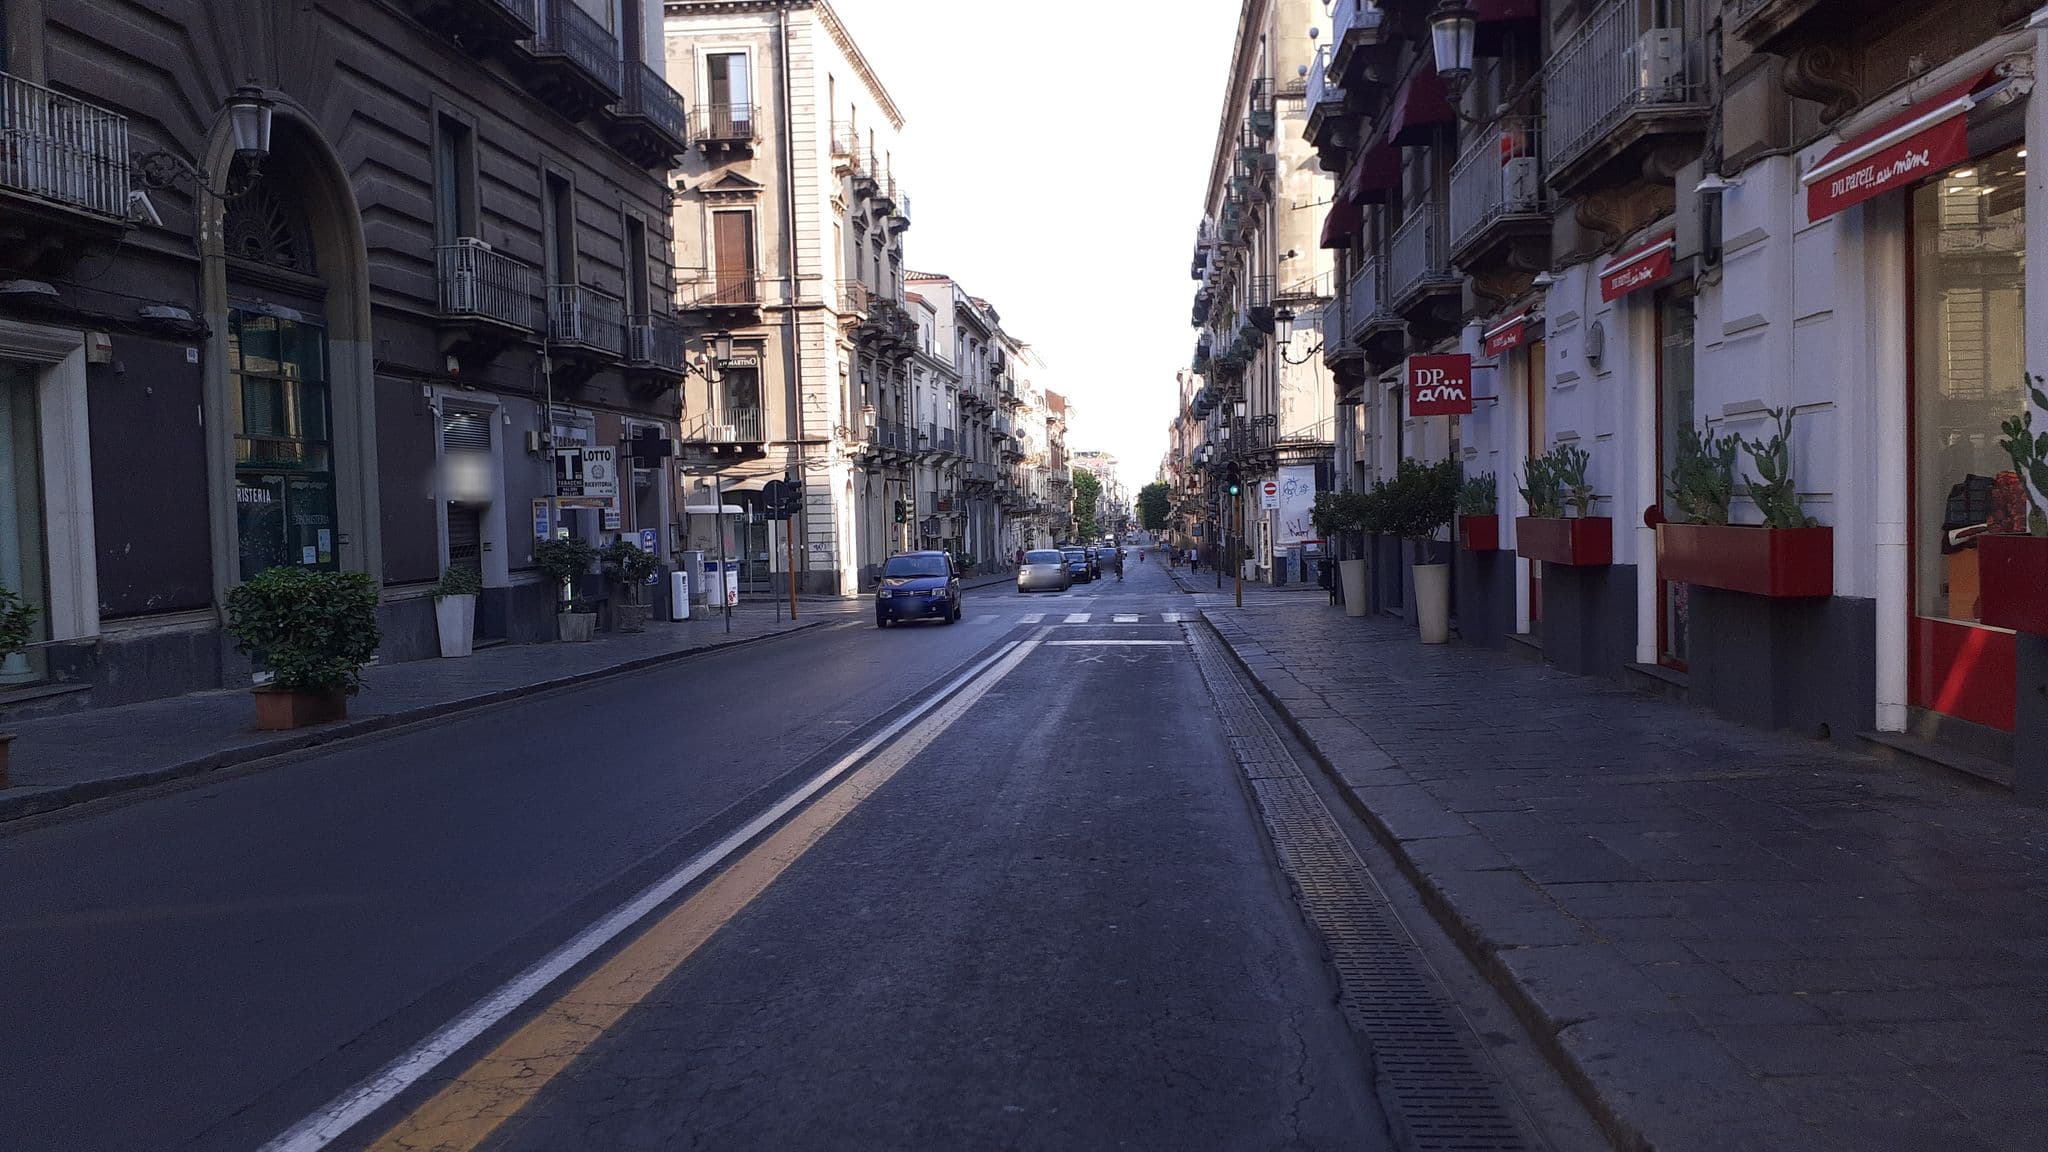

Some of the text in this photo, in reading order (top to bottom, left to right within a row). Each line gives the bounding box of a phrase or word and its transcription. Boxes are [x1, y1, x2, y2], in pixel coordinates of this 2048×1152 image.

[1893, 149, 1930, 175] même
[1831, 180, 1845, 198] DU
[1416, 385, 1467, 402] am
[556, 449, 580, 480] T
[583, 450, 611, 462] LOTTO
